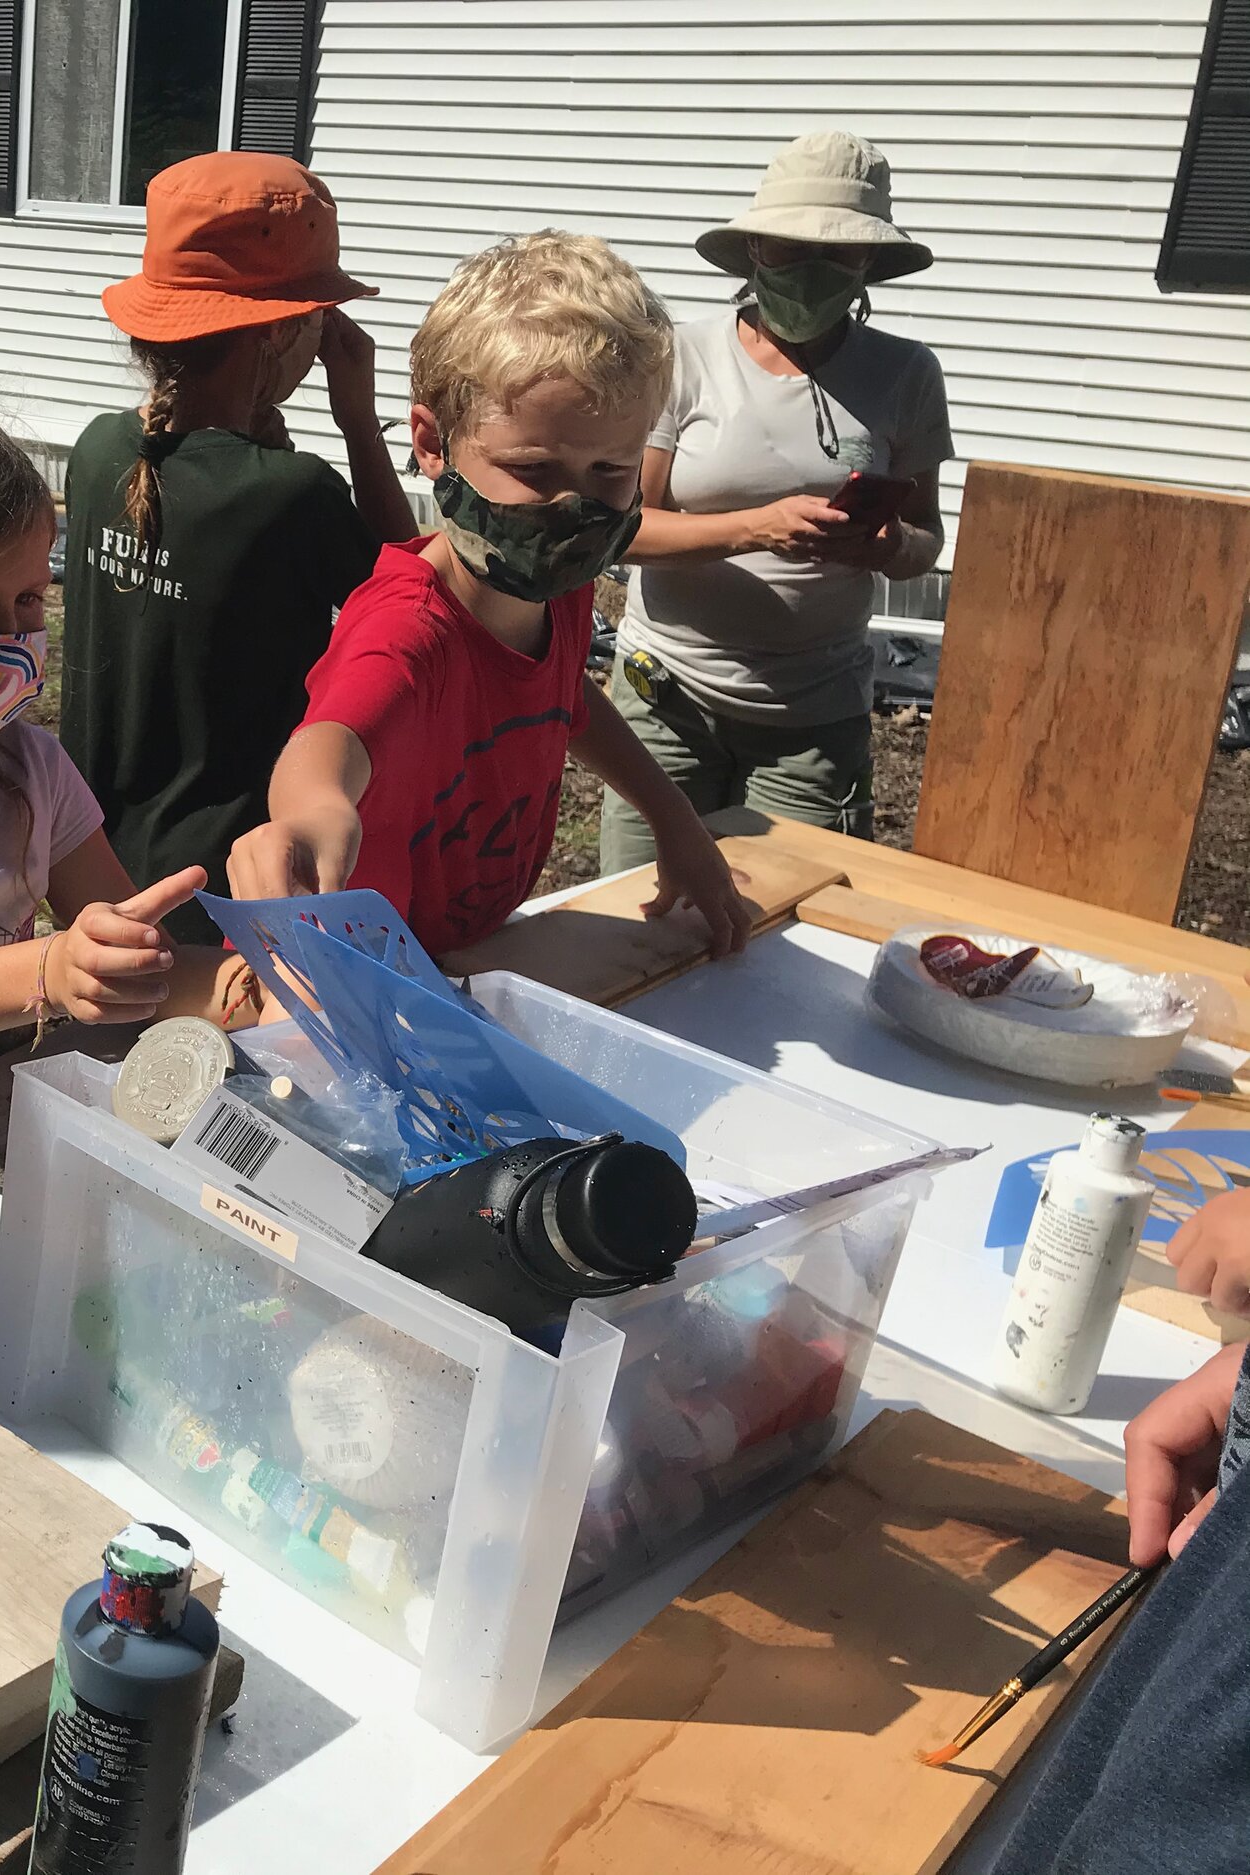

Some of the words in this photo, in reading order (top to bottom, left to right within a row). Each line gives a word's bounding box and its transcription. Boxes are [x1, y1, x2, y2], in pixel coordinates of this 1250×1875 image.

[155, 548, 169, 566] IS
[100, 555, 124, 578] OUR
[131, 568, 188, 600] NAURE.
[216, 1198, 281, 1242] PAINT
[1068, 1621, 1086, 1638] Round
[91, 1725, 118, 1742] Excellent
[100, 1769, 118, 1780] Clean
